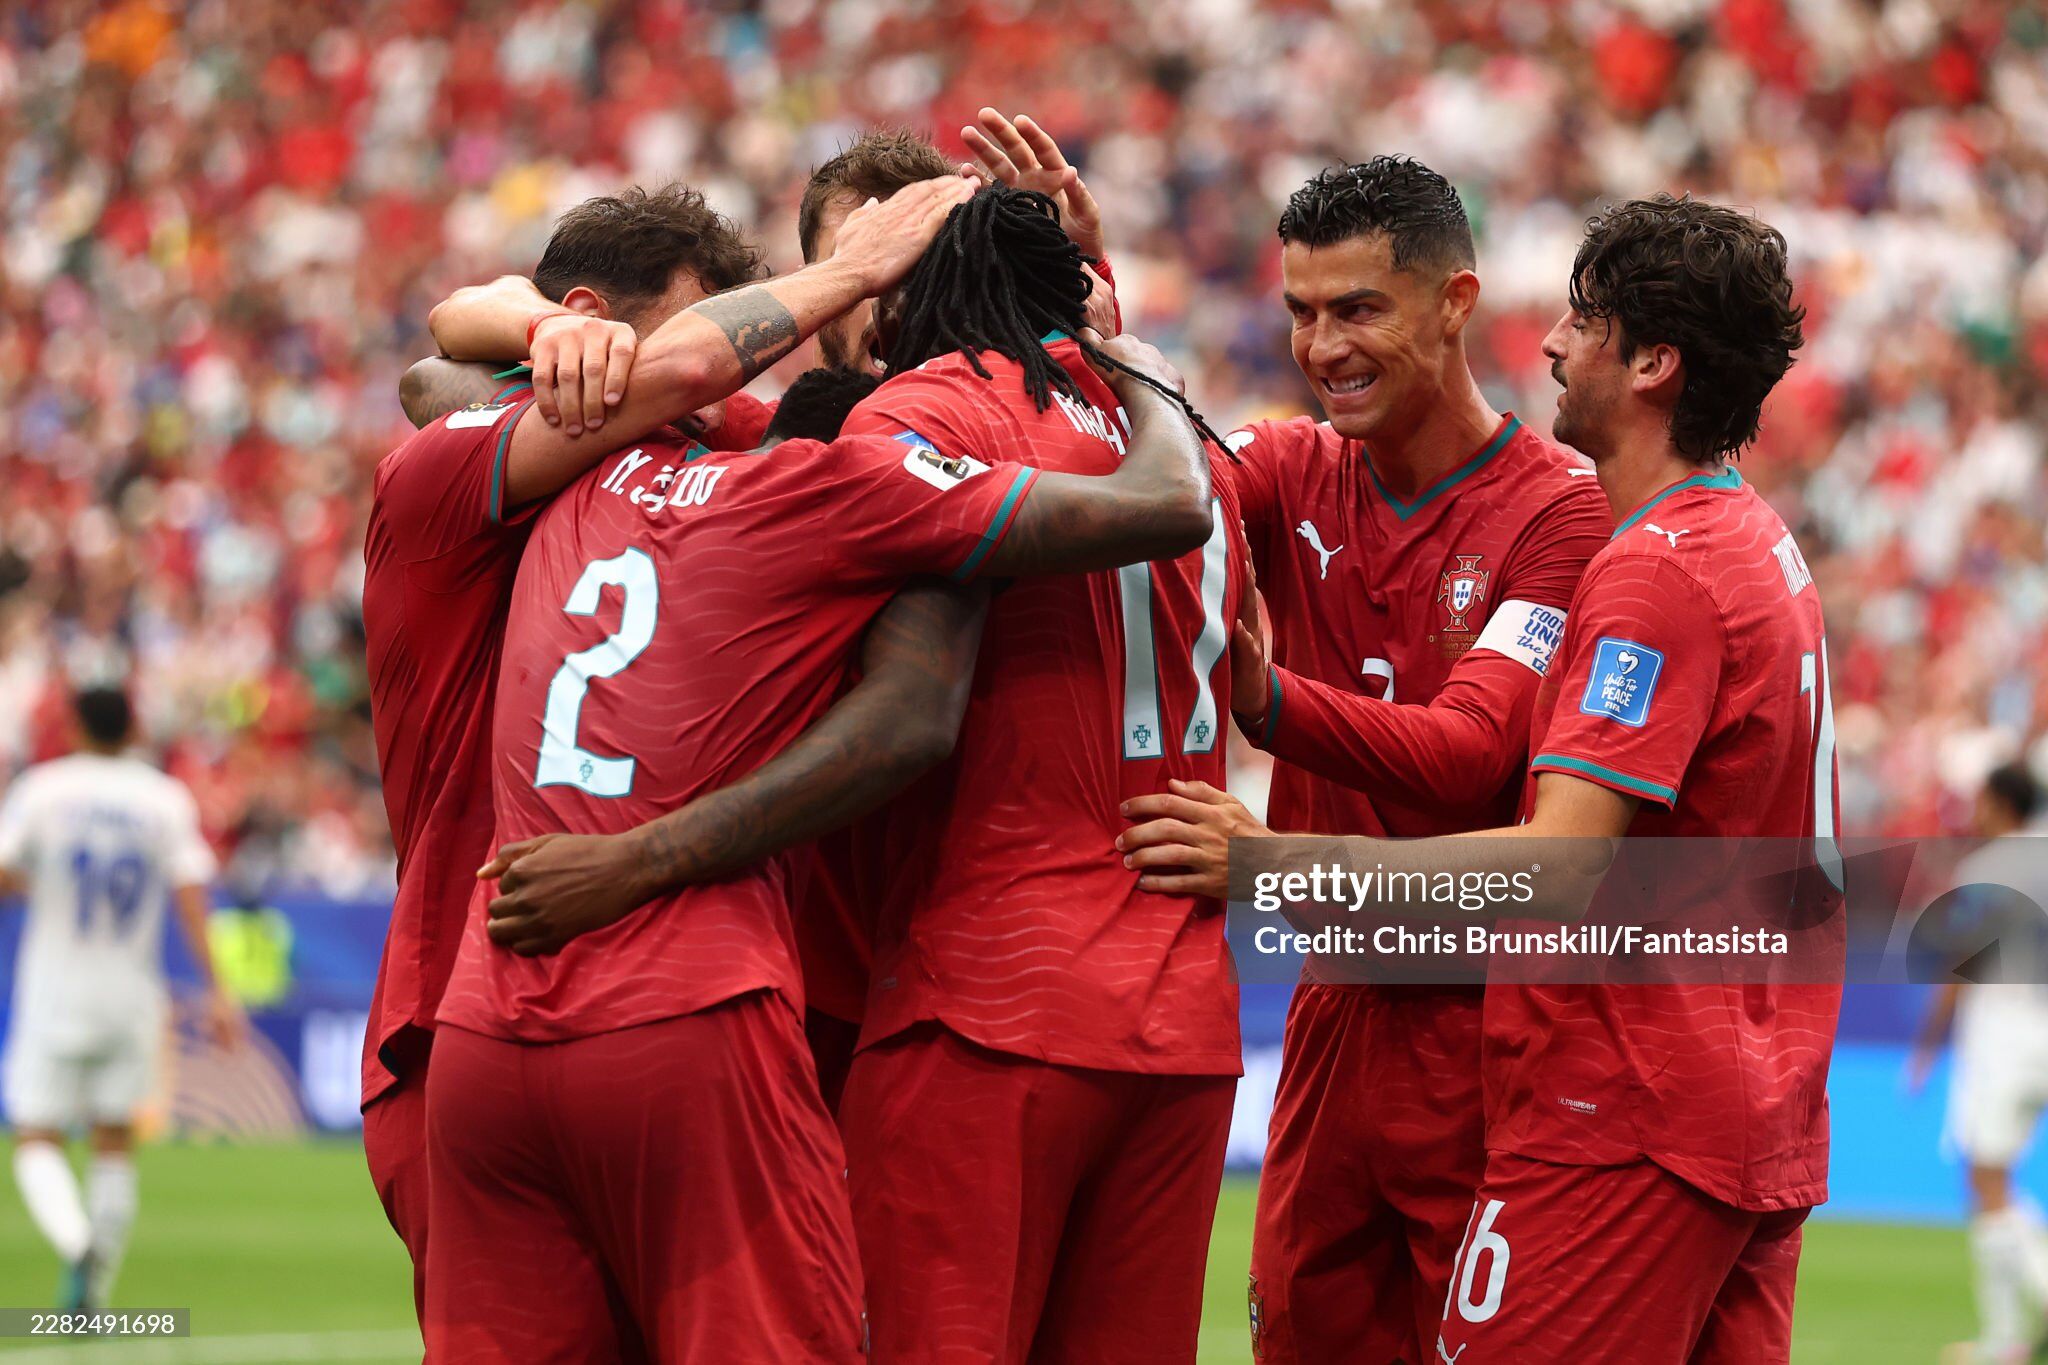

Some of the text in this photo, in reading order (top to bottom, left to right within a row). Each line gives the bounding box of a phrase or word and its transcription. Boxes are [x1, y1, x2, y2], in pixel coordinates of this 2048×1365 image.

[1517, 635, 1543, 654] the
[533, 545, 660, 799] 2
[1601, 686, 1632, 708] PEACE
[1604, 701, 1621, 713] FIFA
